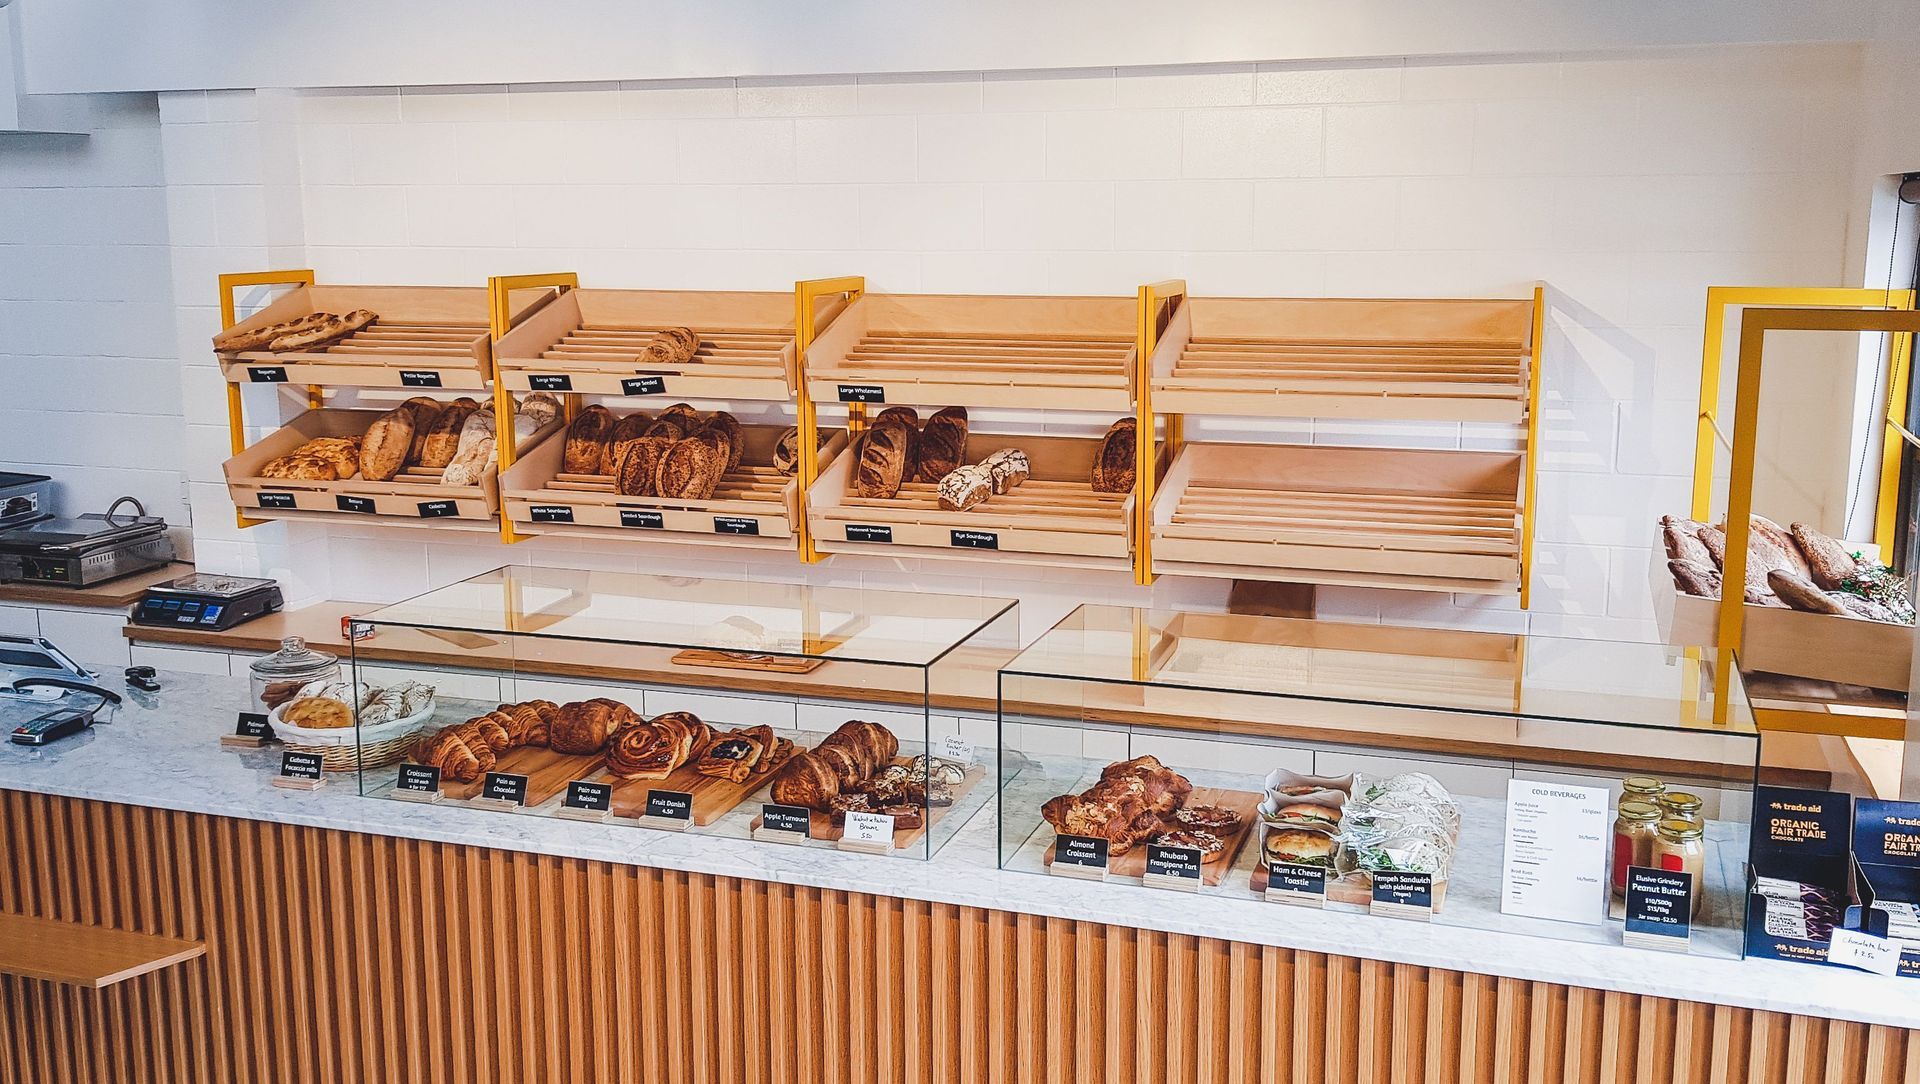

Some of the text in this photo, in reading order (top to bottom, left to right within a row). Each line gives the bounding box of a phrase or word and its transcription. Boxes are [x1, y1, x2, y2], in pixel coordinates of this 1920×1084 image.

[966, 533, 993, 541] Sourdough
[406, 769, 432, 778] Croissant
[496, 777, 508, 785] Pain
[493, 785, 516, 794] Chocolat
[1531, 788, 1586, 800] COLD BEVERAGES
[578, 794, 598, 803] Raisins
[652, 798, 686, 808] Fruit Danish
[1783, 802, 1822, 813] trade aid
[764, 812, 808, 823] Apple Turnover
[1770, 818, 1820, 830] ORGANIC
[1770, 826, 1827, 839] FAIR TRADE
[1770, 834, 1804, 843] CHOCOLATE
[1069, 839, 1095, 849] Almond
[1884, 841, 1908, 851] FAIR
[1066, 849, 1097, 859] Croissant
[1159, 850, 1188, 861] Rhubarb
[1883, 849, 1917, 857] CHOCOLATE
[1150, 859, 1197, 871] Frangipane Tart
[1166, 869, 1180, 877] 6.50
[1273, 865, 1290, 875] Ham
[1297, 868, 1322, 878] Cheese
[1284, 876, 1310, 886] Toastie
[1373, 874, 1431, 884] Tempeh Sandwich
[1635, 874, 1684, 888] Elusive Grindery
[1393, 884, 1414, 892] pickled
[1632, 883, 1687, 897] Peanut Butter
[1645, 897, 1672, 907] $10/500g
[1647, 905, 1669, 914] $15/1kg
[1789, 945, 1816, 955] trade
